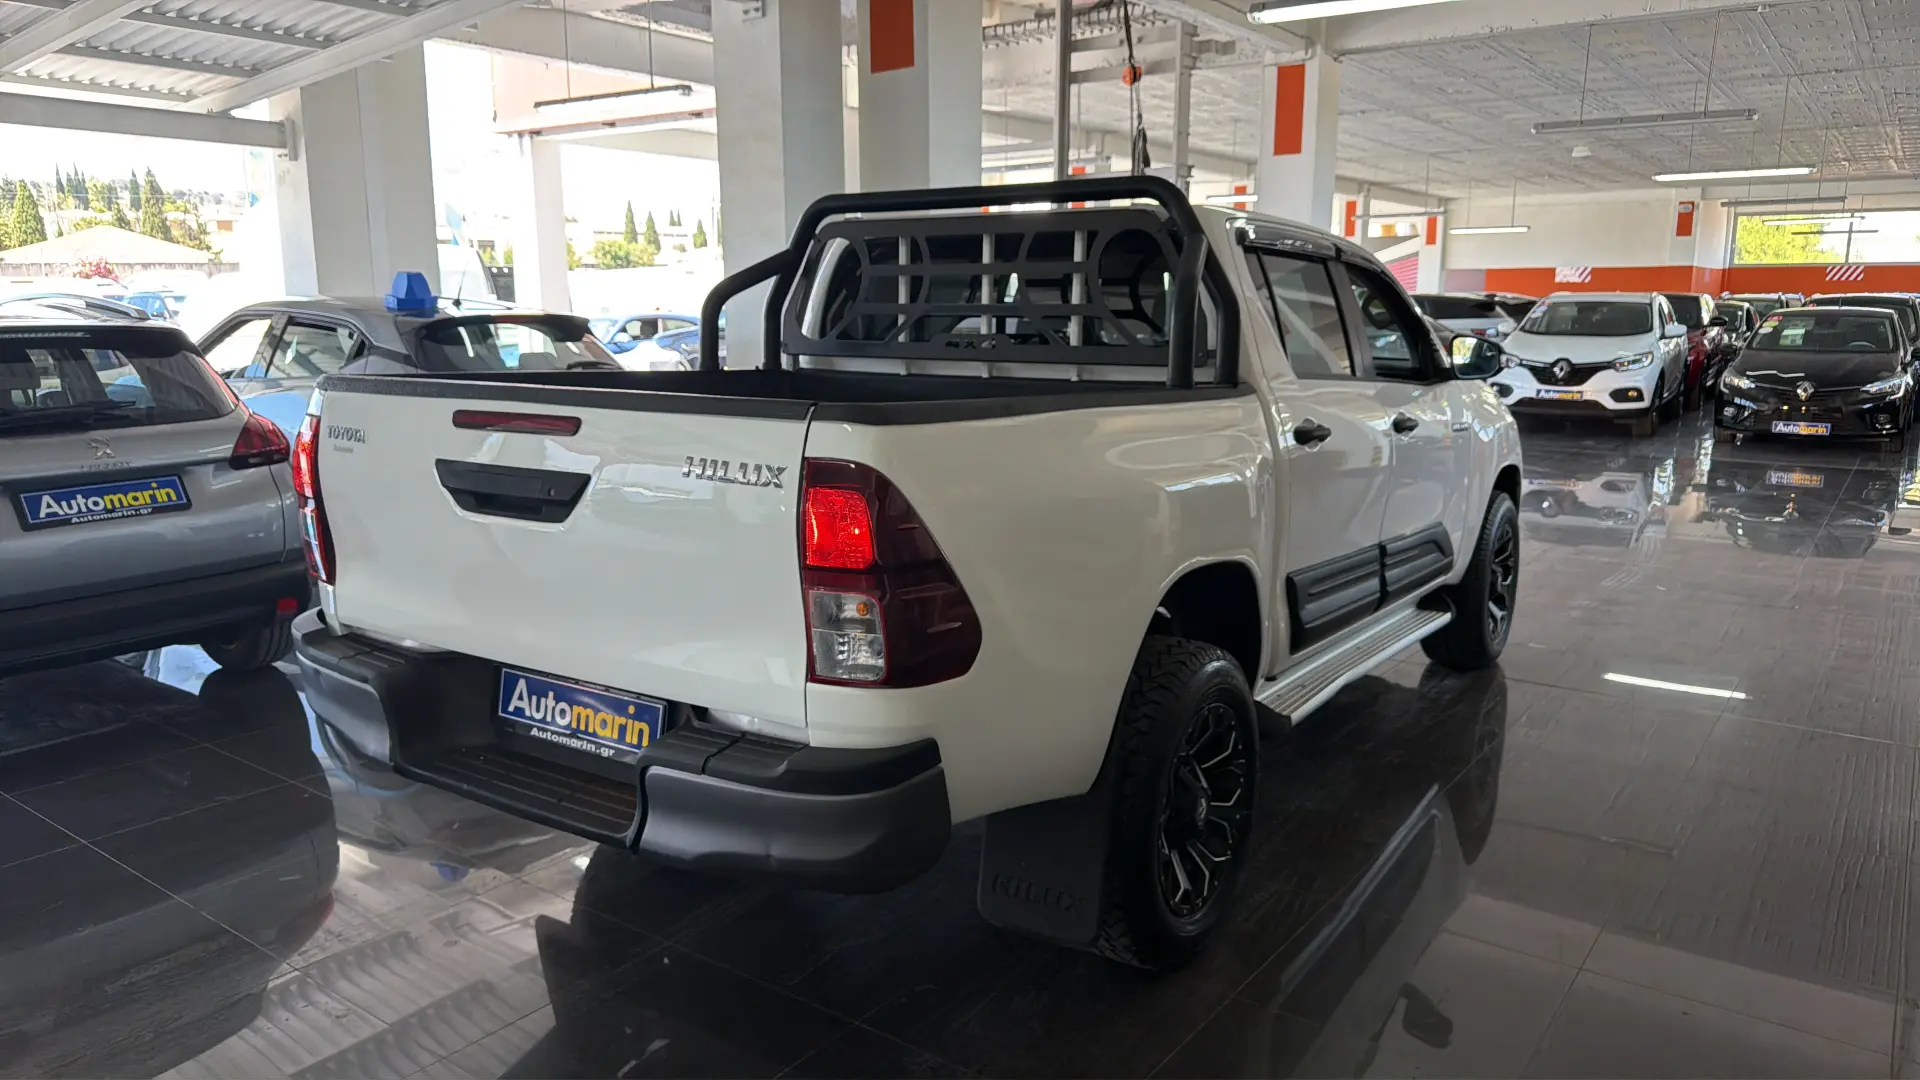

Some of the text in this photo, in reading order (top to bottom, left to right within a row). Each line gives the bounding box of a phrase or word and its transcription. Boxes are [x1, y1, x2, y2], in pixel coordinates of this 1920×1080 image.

[1539, 389, 1582, 400] Automarin
[327, 425, 366, 444] TOYOTA
[1776, 422, 1827, 434] Automarin
[682, 455, 789, 489] HILUX
[39, 482, 177, 519] Automarin
[70, 507, 154, 524] Automarin.gr
[508, 678, 650, 747] Automarin
[530, 727, 616, 757] Automarin.gr
